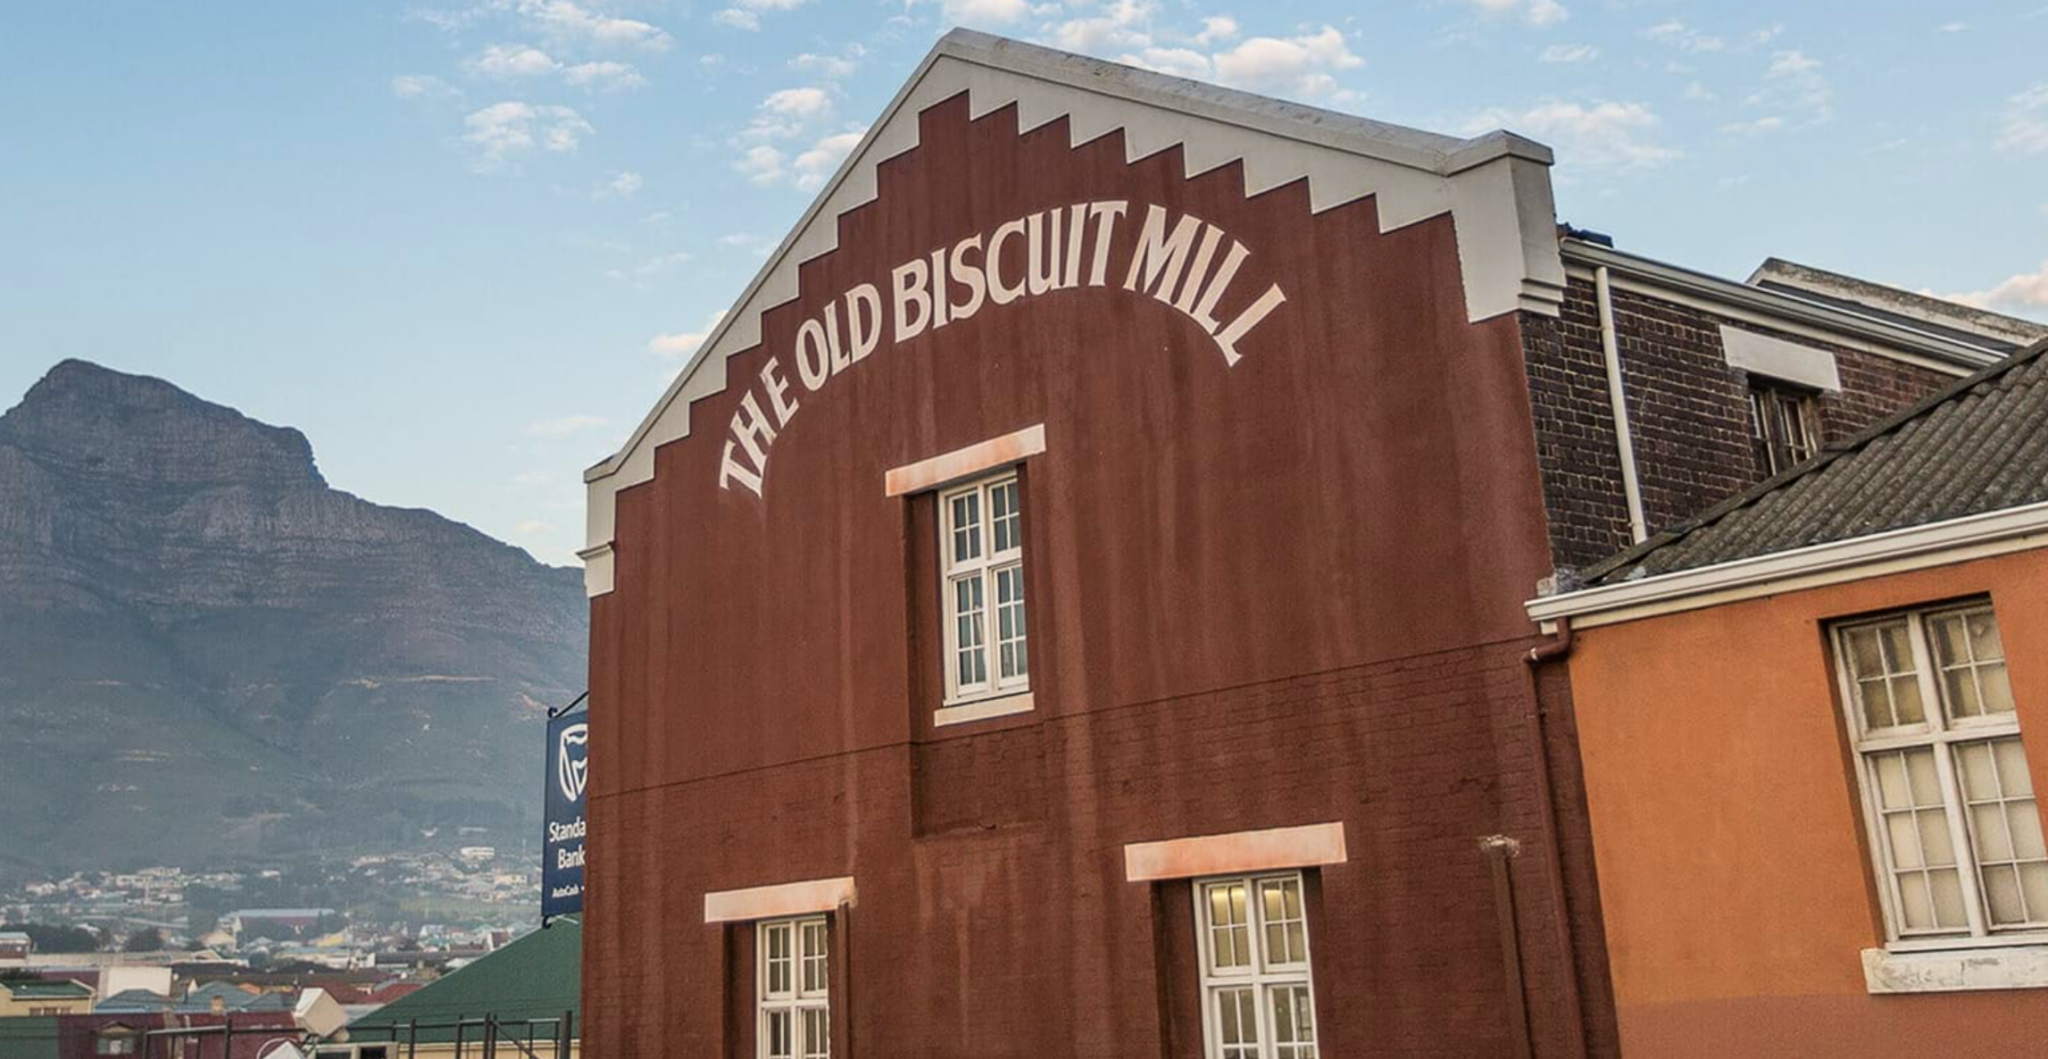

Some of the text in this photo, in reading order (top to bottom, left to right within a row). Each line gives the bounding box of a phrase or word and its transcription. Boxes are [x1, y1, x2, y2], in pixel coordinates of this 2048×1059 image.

[719, 200, 1287, 498] THE OLD BISCUIT MILL
[549, 816, 586, 842] Standa
[558, 844, 586, 870] Bank
